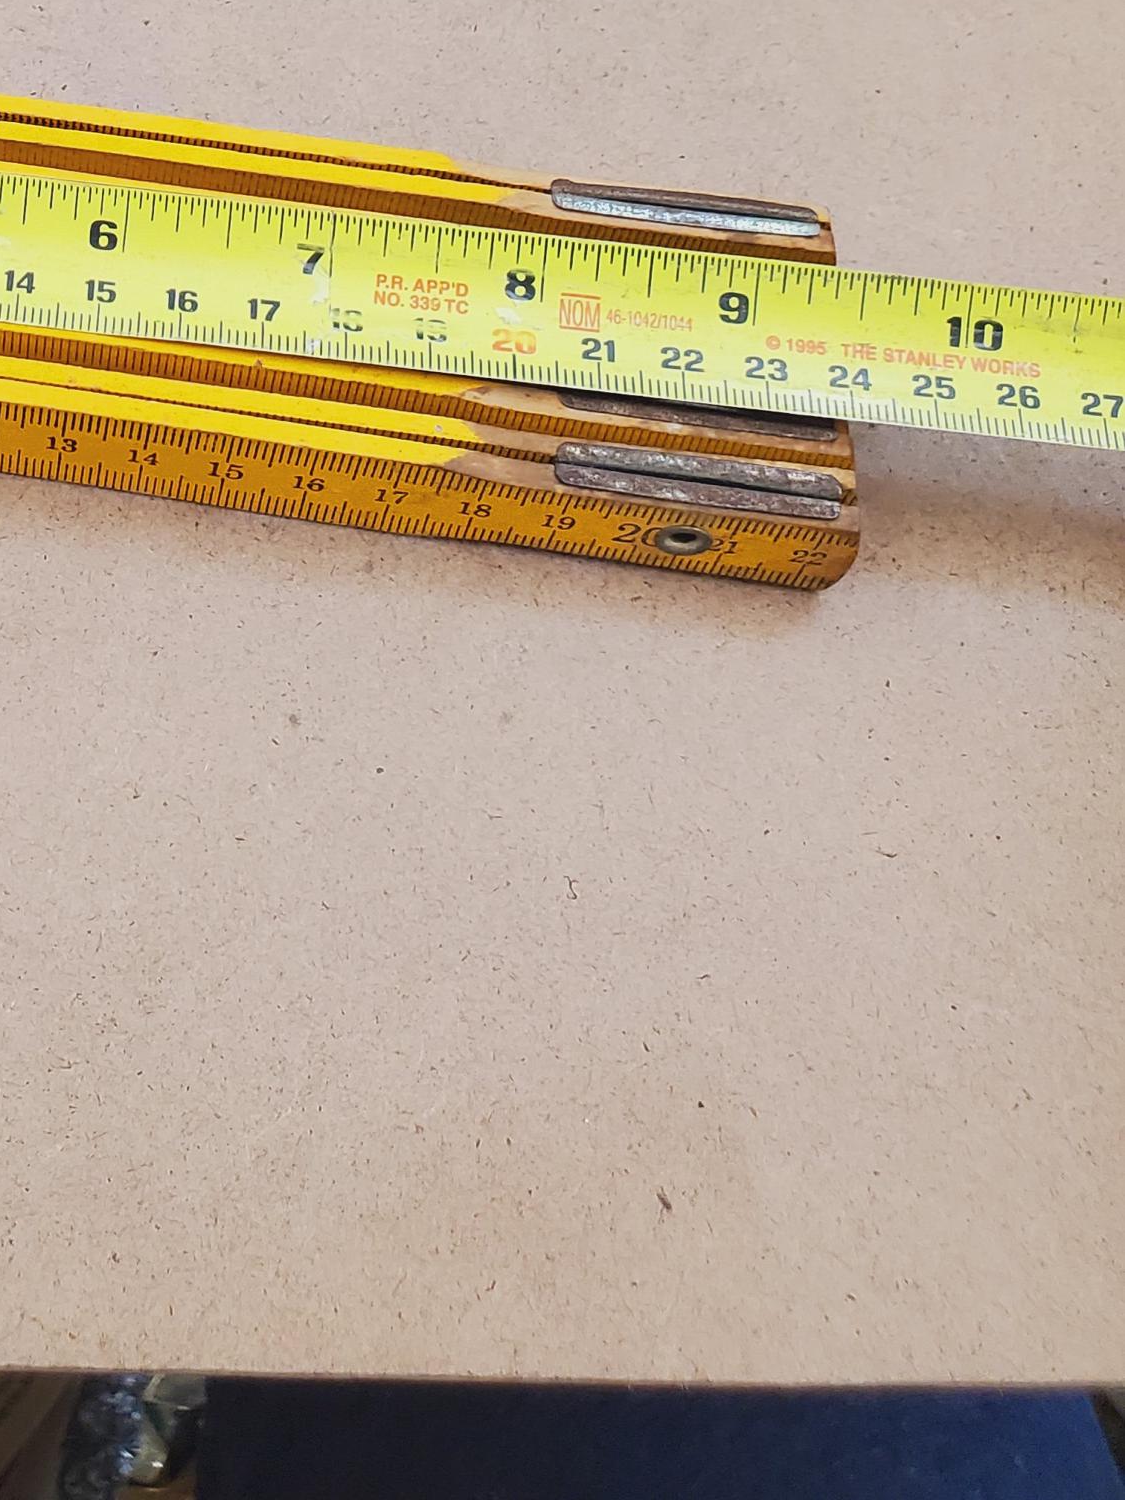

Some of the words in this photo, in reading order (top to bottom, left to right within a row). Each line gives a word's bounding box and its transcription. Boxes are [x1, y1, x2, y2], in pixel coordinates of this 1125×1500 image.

[89, 220, 118, 251] 6
[297, 243, 325, 275] 7
[504, 268, 536, 301] 8
[718, 291, 750, 325] 9
[946, 316, 1004, 351] 10
[374, 290, 404, 307] NO.
[444, 298, 469, 315] TC
[376, 273, 408, 291] P.R.
[412, 278, 469, 297] APP'D
[559, 298, 601, 329] NOM
[5, 270, 35, 294] 14
[85, 279, 117, 303] 15
[166, 288, 199, 313] 16
[248, 298, 280, 322] 17
[492, 328, 537, 355] 20
[582, 338, 616, 363] 21
[660, 347, 705, 372] 22
[745, 356, 788, 382] 23
[828, 365, 872, 391] 24
[912, 374, 956, 400] 25
[996, 383, 1041, 409] 26
[1081, 392, 1124, 418] 27
[786, 339, 827, 356] 1995
[841, 343, 877, 361] THE
[883, 348, 966, 370] STANLEY
[971, 357, 1041, 379] WORKS
[45, 436, 78, 453] 13
[127, 449, 160, 466] 14
[207, 462, 244, 480] 15
[292, 476, 325, 492] 16
[375, 489, 409, 505] 17
[459, 501, 492, 518] 18
[541, 514, 575, 530] 19
[789, 549, 828, 566] 22
